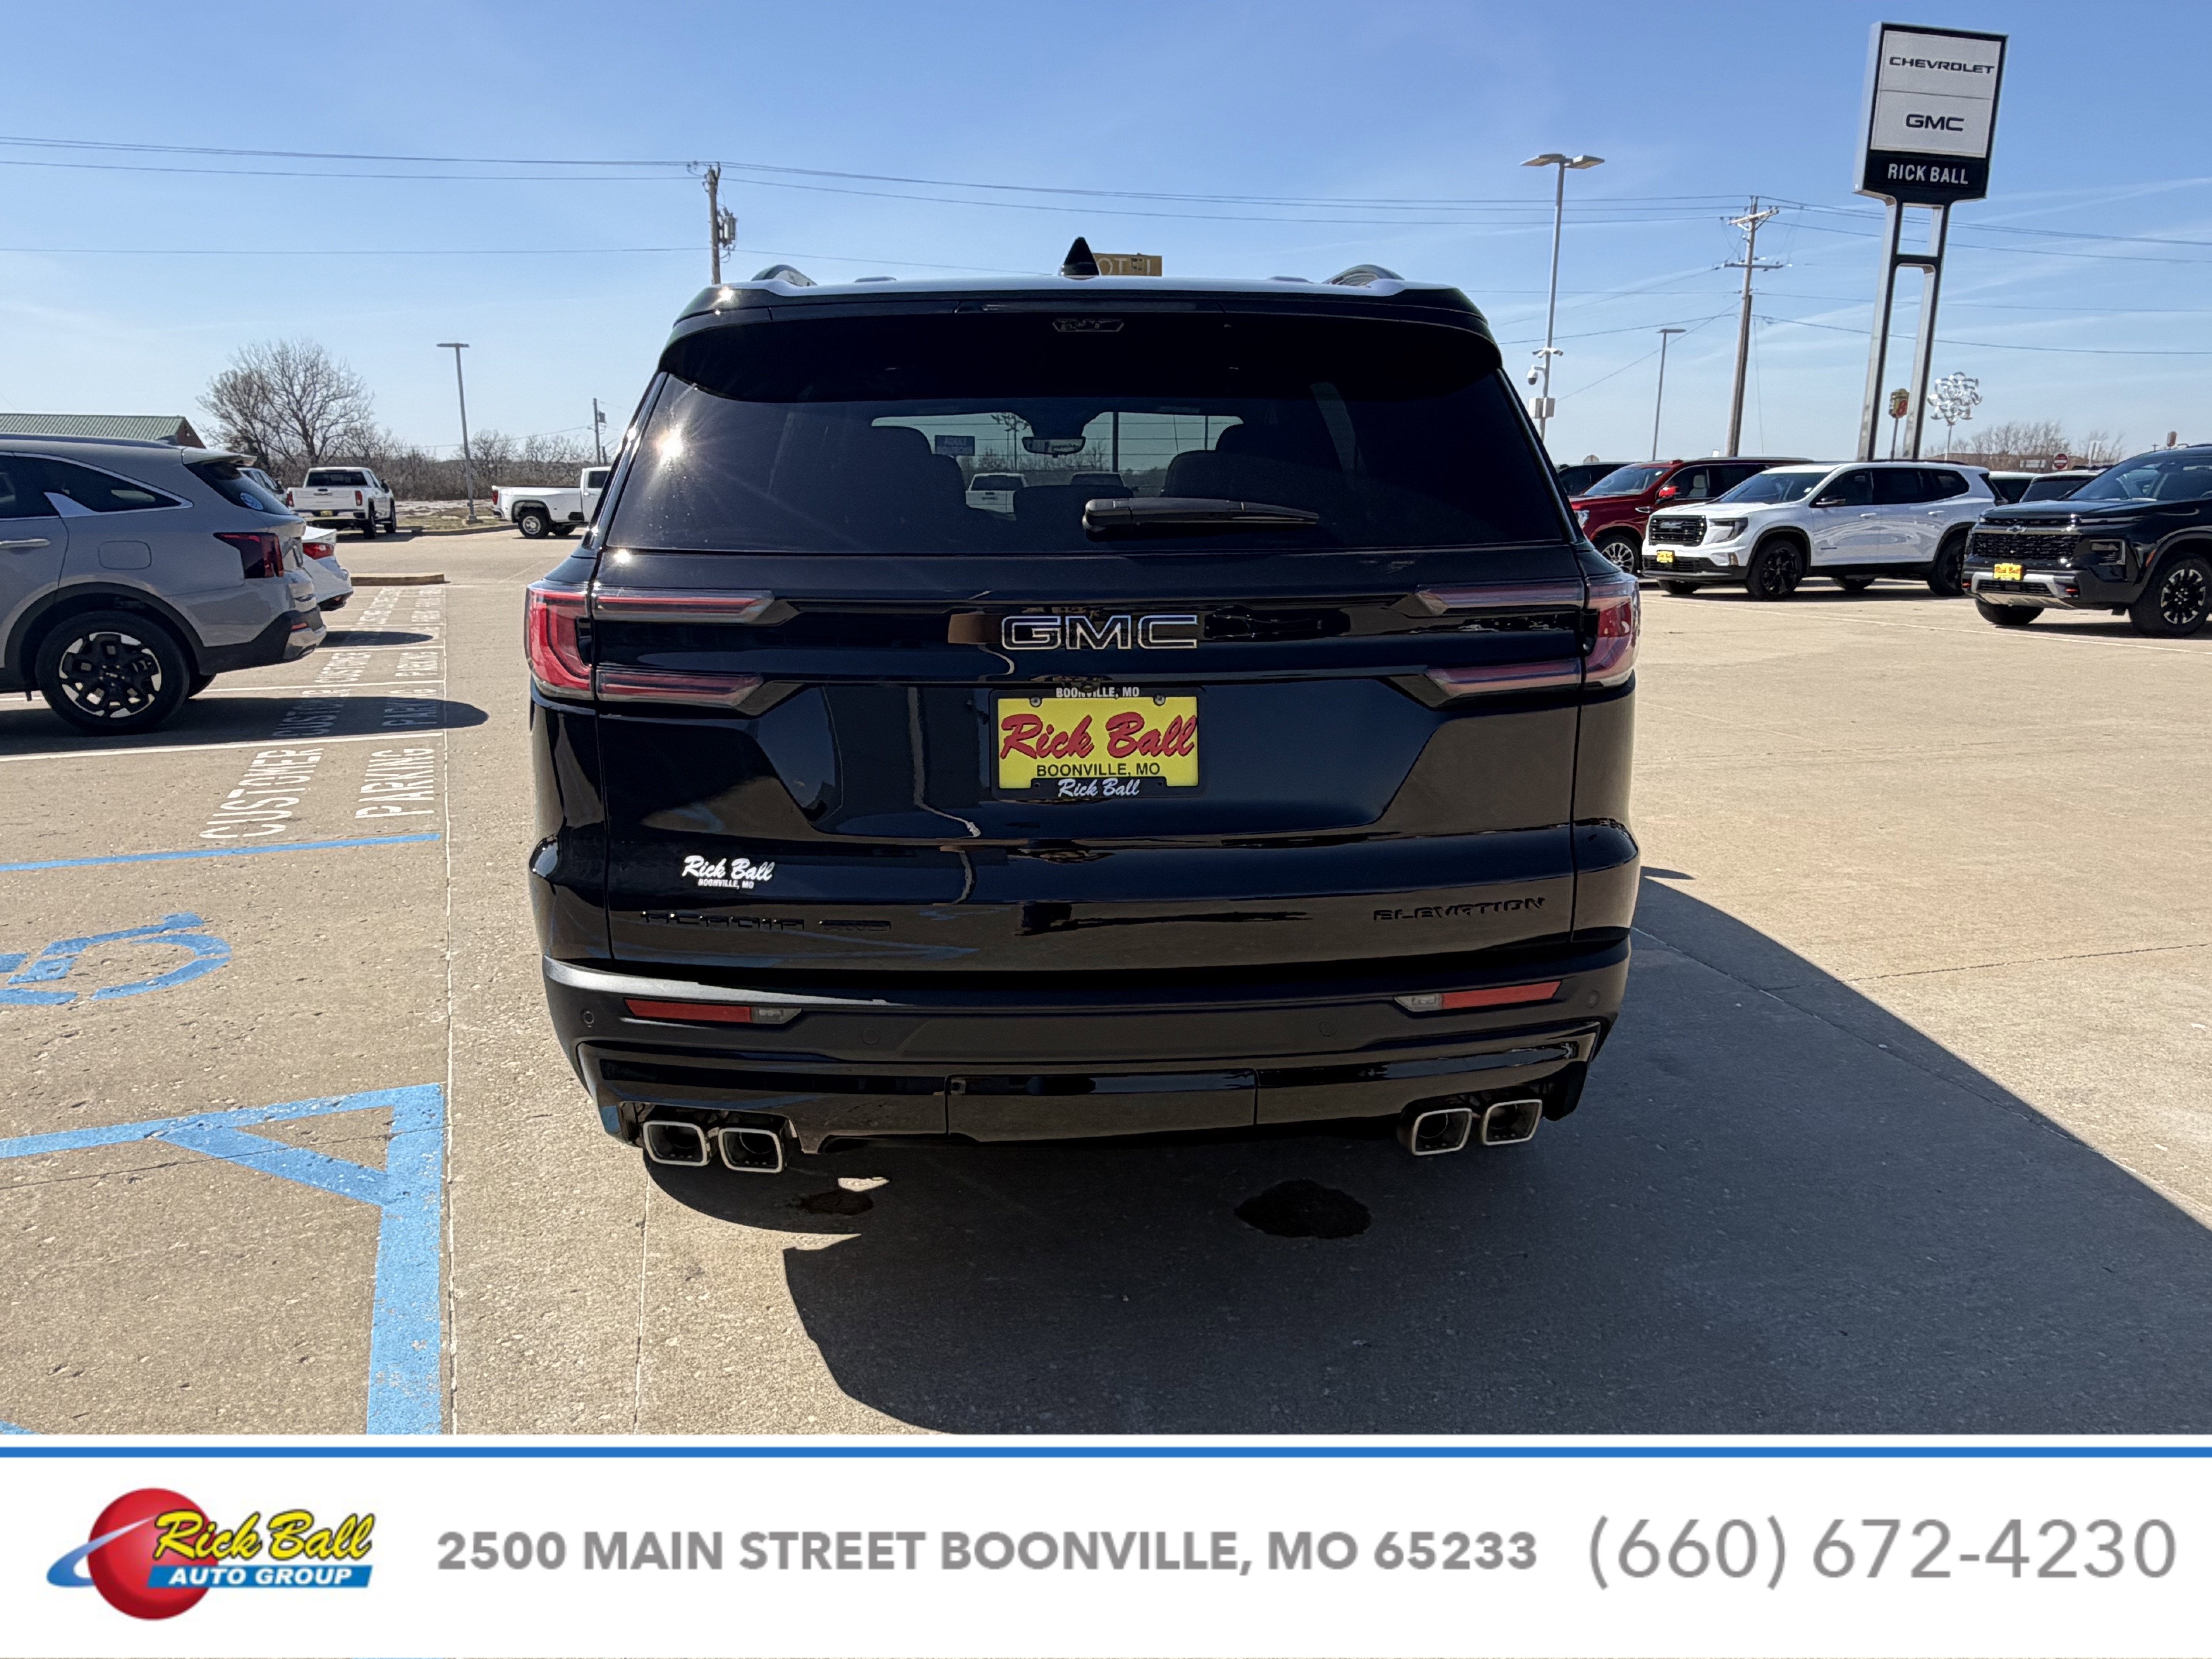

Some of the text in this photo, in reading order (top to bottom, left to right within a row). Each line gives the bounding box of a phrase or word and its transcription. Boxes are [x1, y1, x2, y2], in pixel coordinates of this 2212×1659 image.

[1889, 56, 1995, 74] CHEVROLET
[1905, 113, 1965, 132] GMC
[1887, 163, 1969, 185] RICK BALL
[1001, 615, 1198, 650] GMC
[1122, 687, 1140, 697] MO
[1000, 712, 1197, 759] Rick Ball
[1036, 763, 1160, 777] BOONVILLE, MO
[199, 748, 324, 839] CUSTOMER
[355, 748, 434, 819] PARKING
[1058, 778, 1140, 797] Rick Ball
[682, 855, 775, 881] Rick Ball
[1373, 896, 1545, 921] ELEVATION
